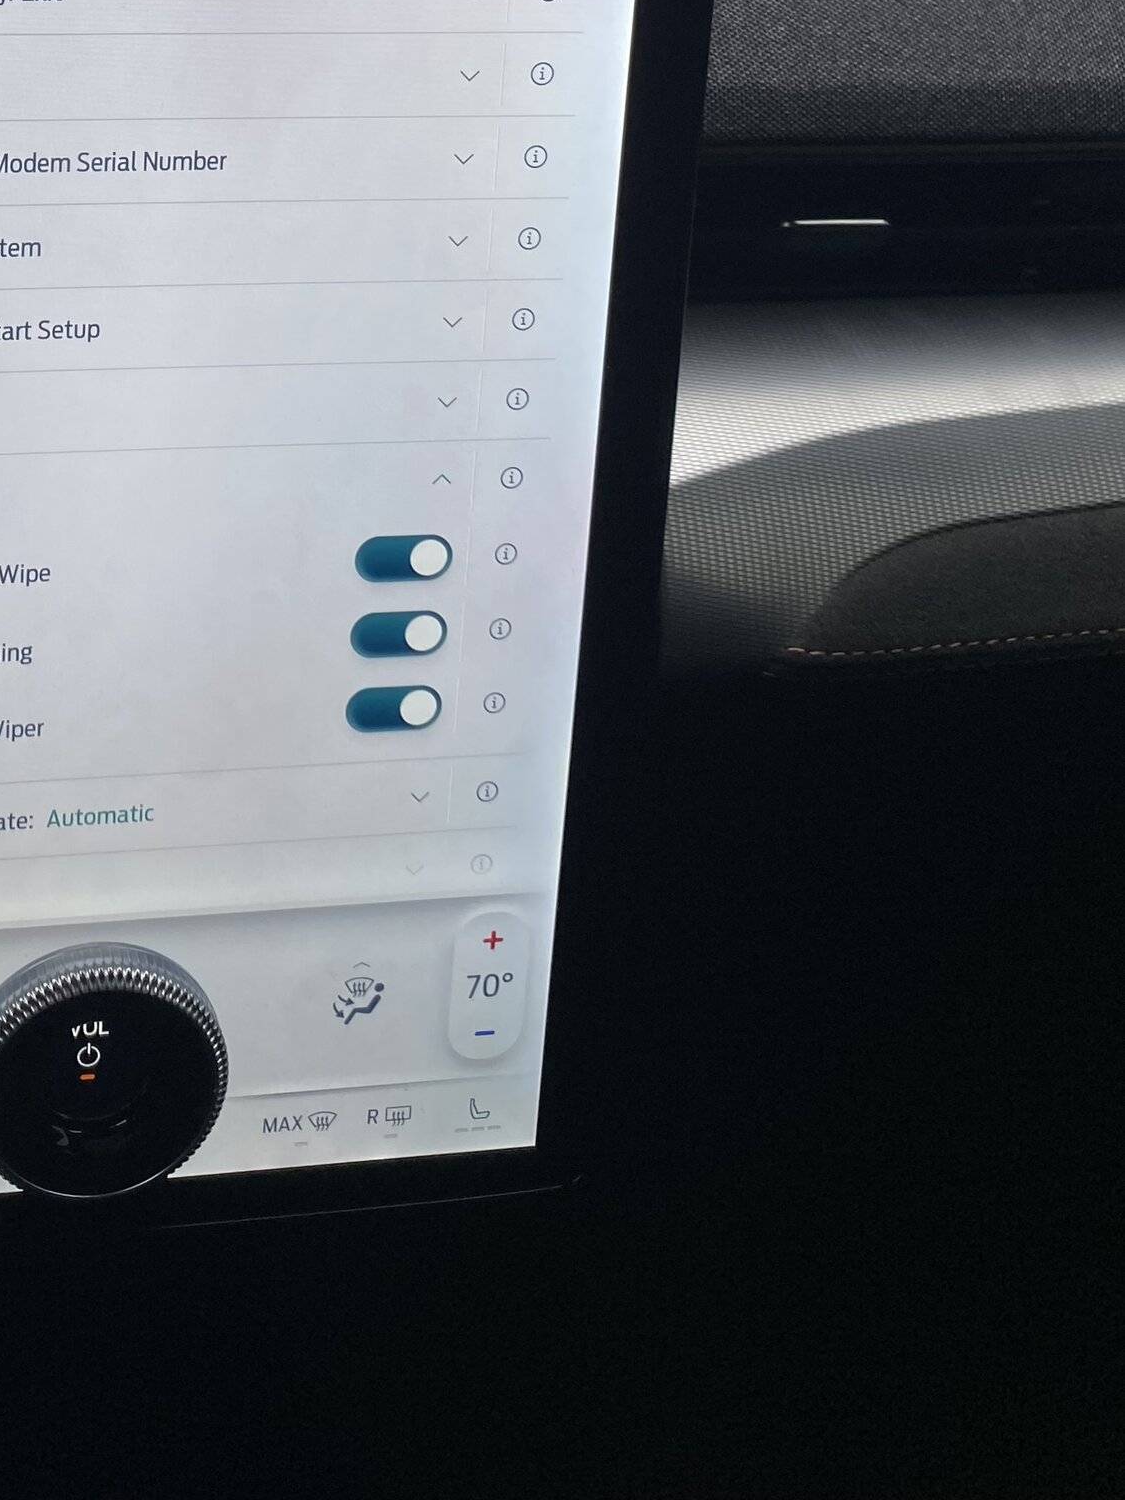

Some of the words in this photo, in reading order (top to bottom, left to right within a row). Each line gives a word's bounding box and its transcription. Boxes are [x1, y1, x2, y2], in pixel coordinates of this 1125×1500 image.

[77, 151, 136, 172] Serial
[144, 150, 227, 171] Number
[38, 320, 100, 342] Setup
[47, 804, 153, 827] Automatic
[467, 973, 513, 998] 70°
[263, 1115, 302, 1133] MAX
[368, 1109, 378, 1124] R
